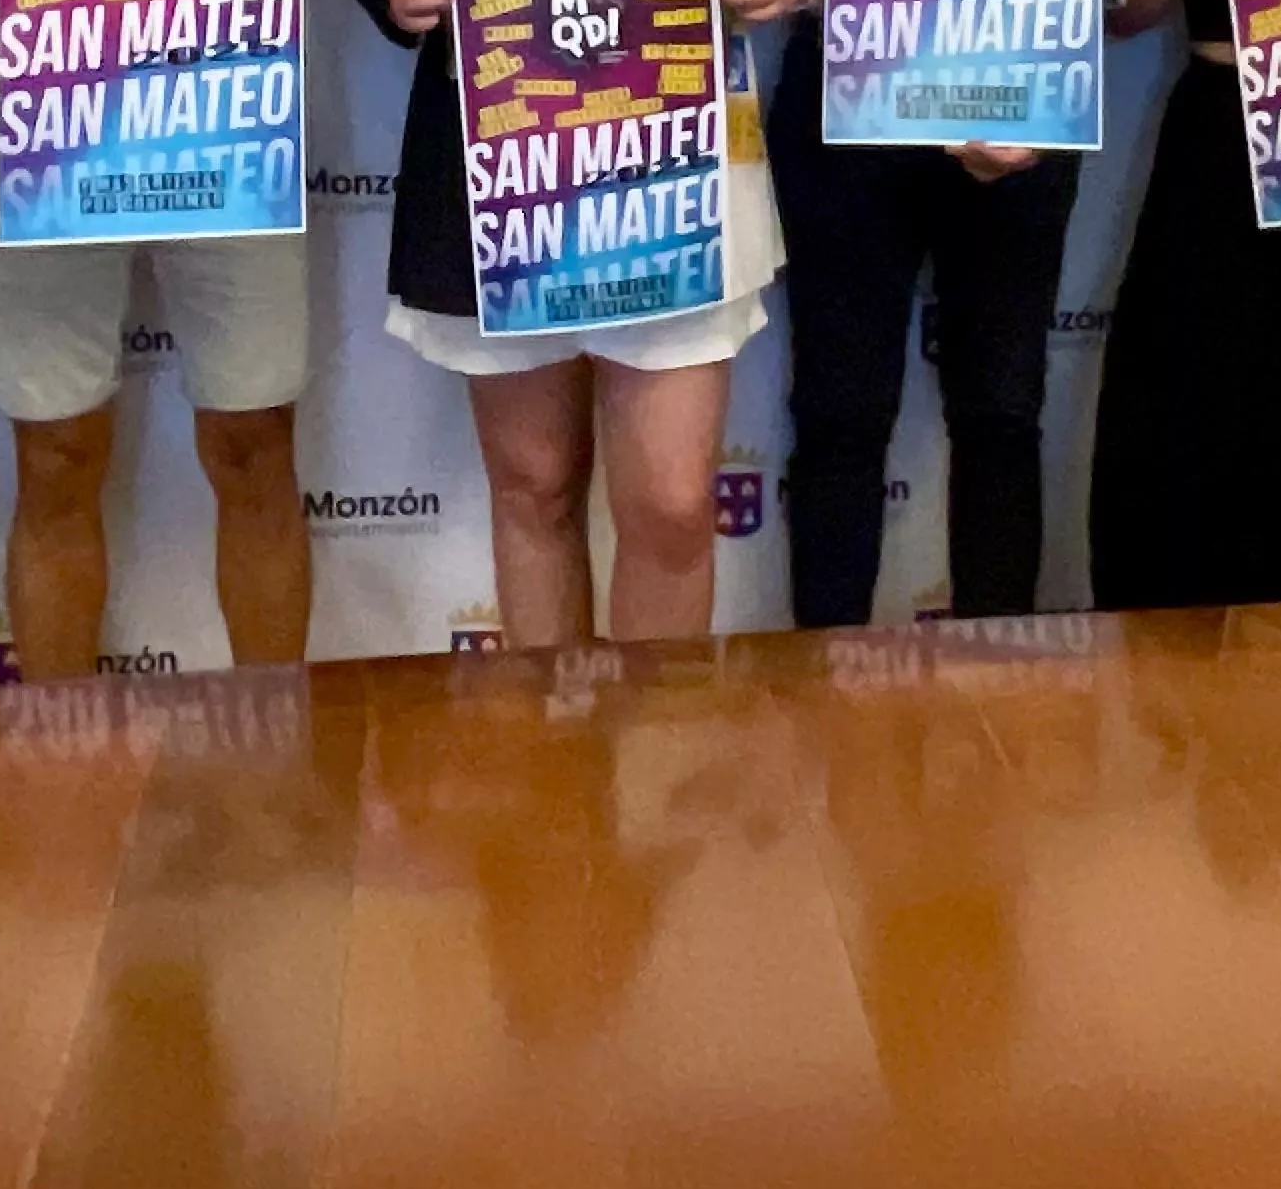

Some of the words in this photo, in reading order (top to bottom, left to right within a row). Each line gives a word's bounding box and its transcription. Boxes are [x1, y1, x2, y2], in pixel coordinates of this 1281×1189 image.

[0, 4, 104, 79] SAN
[552, 8, 619, 57] QD!
[827, 0, 922, 63] SAN
[0, 81, 106, 155] SAN
[121, 62, 294, 141] MATEO
[306, 167, 400, 195] Monz
[468, 132, 558, 201] SAN
[572, 101, 720, 186] MATEO
[474, 203, 563, 270] SAN
[578, 170, 721, 256] MATEO
[304, 486, 440, 518] Monzón
[96, 645, 177, 674] nzón
